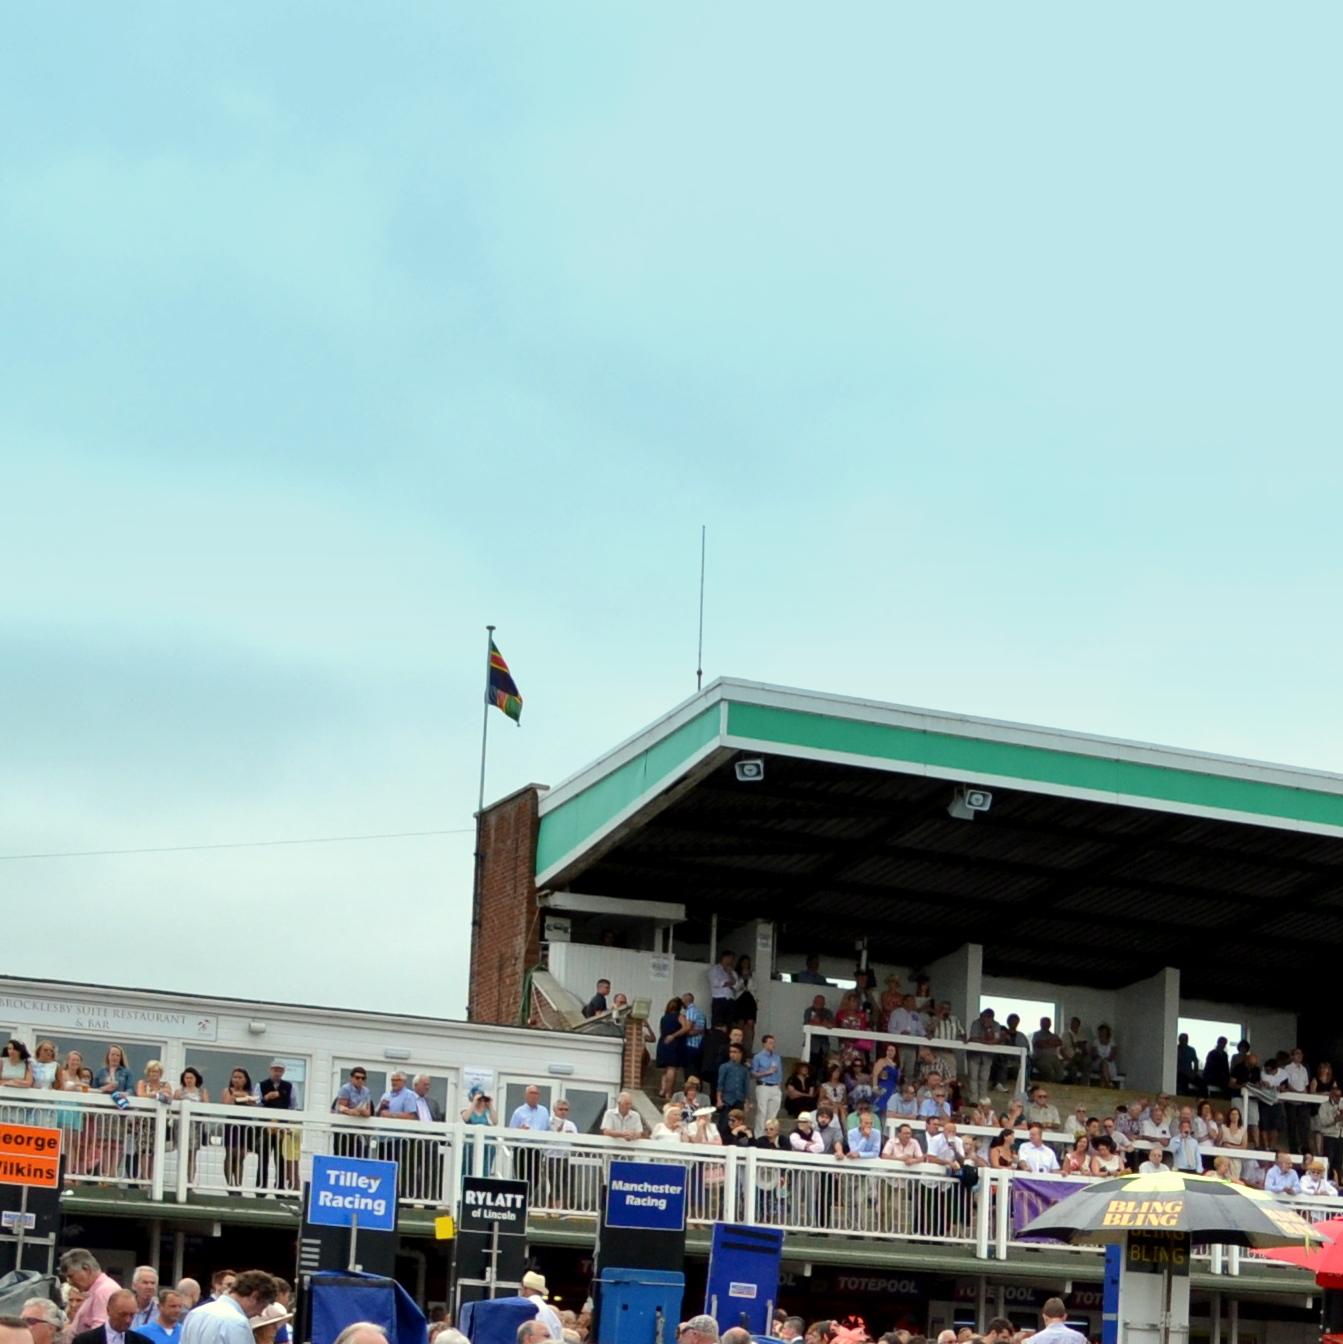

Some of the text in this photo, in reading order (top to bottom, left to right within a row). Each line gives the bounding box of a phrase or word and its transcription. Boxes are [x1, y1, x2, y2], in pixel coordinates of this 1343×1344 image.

[75, 1006, 109, 1018] SUITE
[112, 1008, 187, 1025] RESTAURANT
[0, 1132, 57, 1152] eorge
[326, 1170, 382, 1193] Tilley
[611, 1179, 683, 1196] Manchester
[318, 1191, 387, 1216] Racing
[465, 1190, 525, 1209] RYLATT
[625, 1195, 667, 1211] Racing
[1106, 1200, 1184, 1214] BLING
[471, 1209, 518, 1222] of Lincoln
[1102, 1213, 1179, 1227] BLING
[1130, 1244, 1185, 1265] BLING
[837, 1276, 919, 1294] TOTEPOOL
